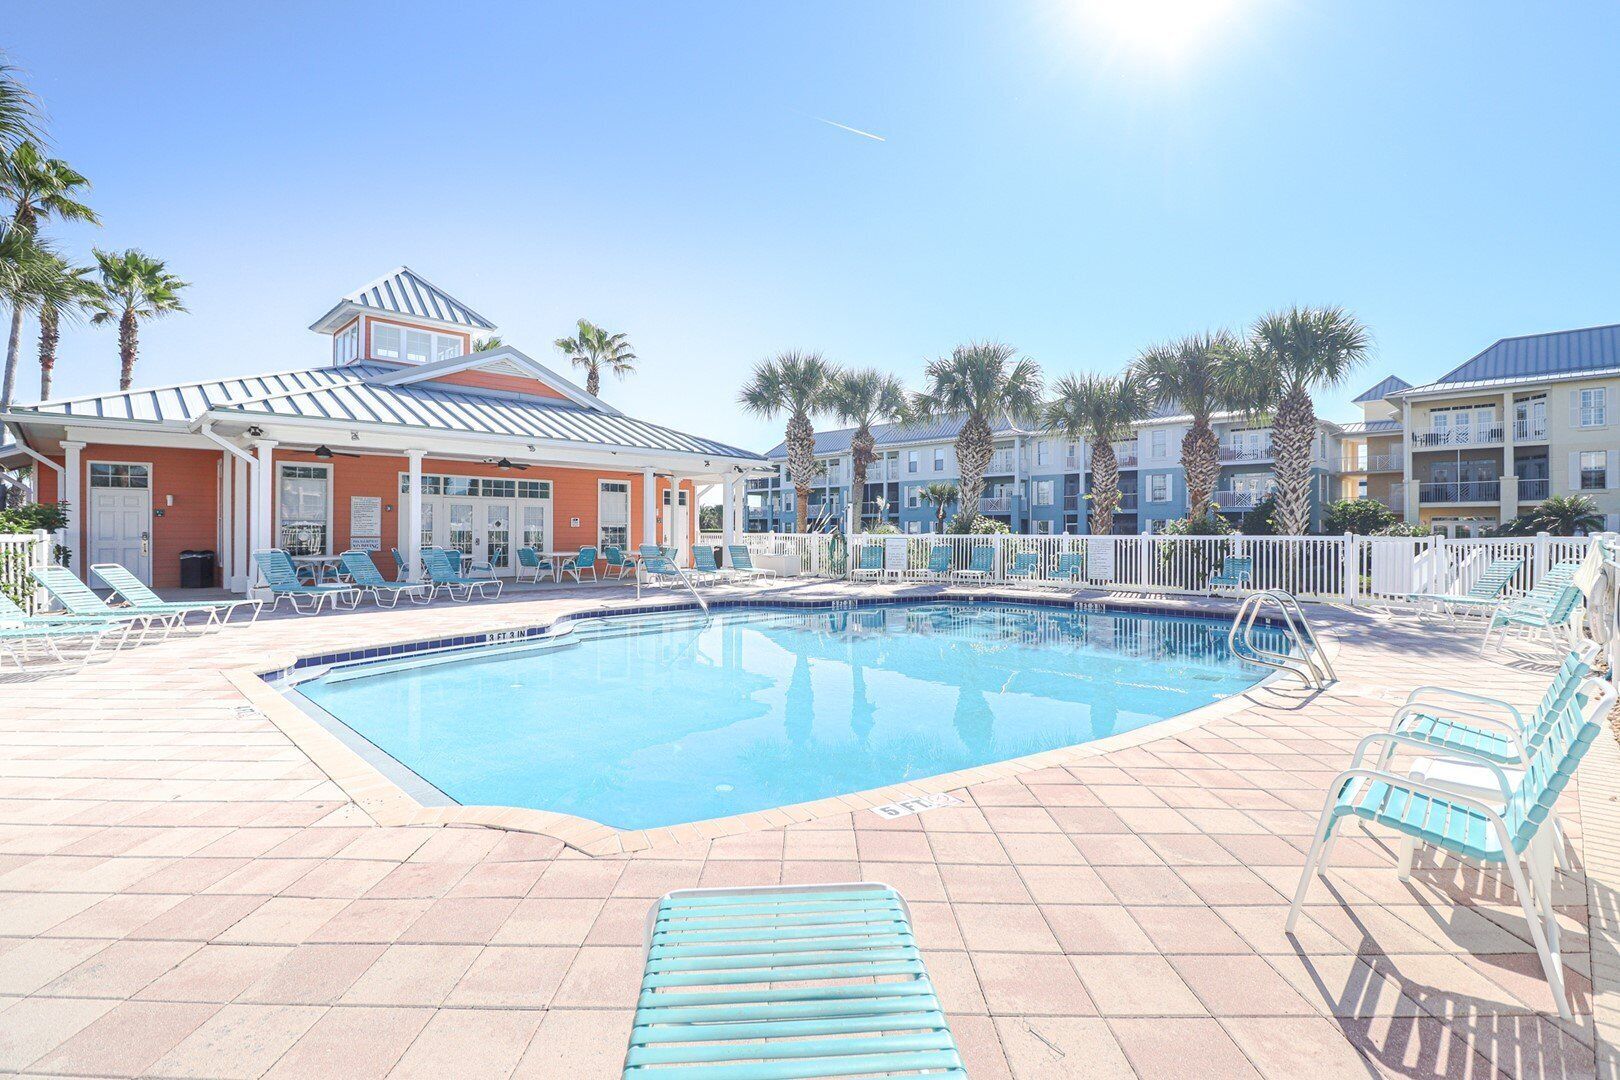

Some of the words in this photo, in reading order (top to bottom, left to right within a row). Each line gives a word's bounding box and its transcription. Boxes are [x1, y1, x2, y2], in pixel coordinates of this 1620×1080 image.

[497, 632, 507, 640] FT
[517, 630, 526, 638] IN
[880, 806, 900, 816] 5
